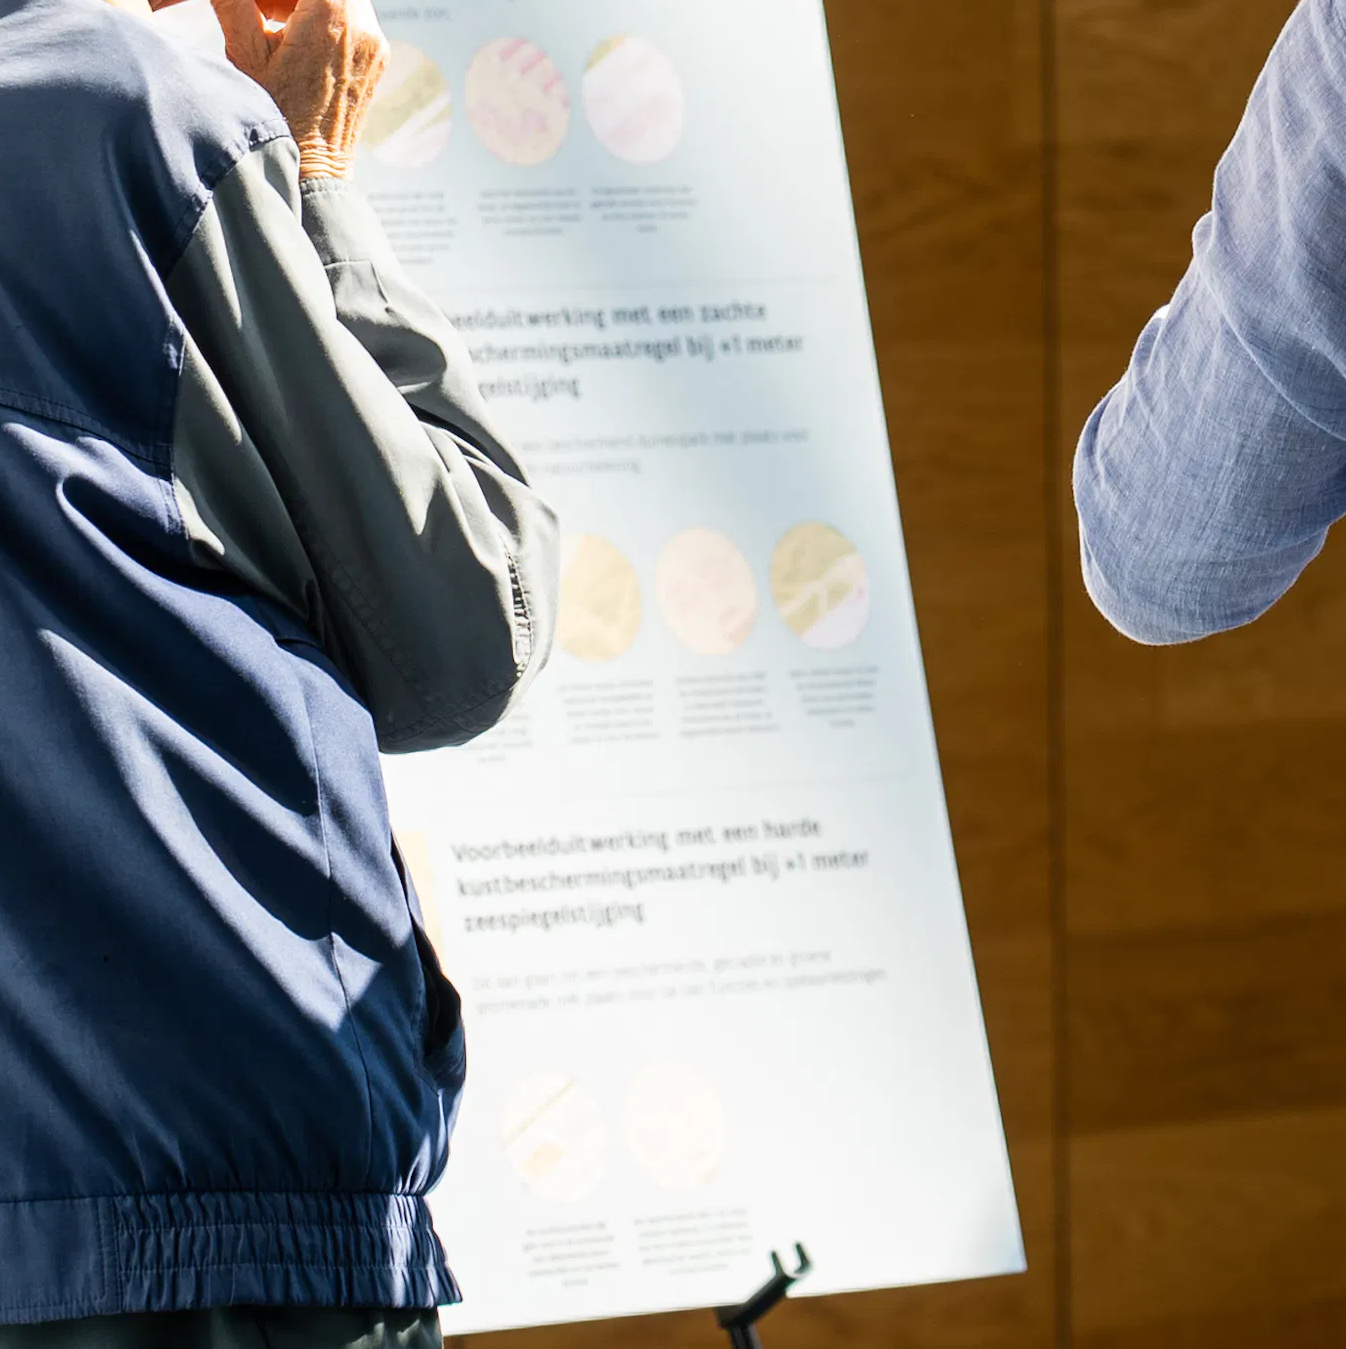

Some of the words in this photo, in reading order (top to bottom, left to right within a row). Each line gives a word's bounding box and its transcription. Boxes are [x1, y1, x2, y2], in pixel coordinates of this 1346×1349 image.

[611, 304, 651, 326] met
[658, 303, 695, 323] een
[700, 299, 768, 323] zachte
[686, 334, 715, 363] bij
[745, 334, 805, 354] meter
[451, 831, 670, 863] Voorbeelduitwerking
[676, 825, 715, 845] met
[722, 823, 758, 842] een
[762, 816, 822, 839] harde
[456, 856, 746, 896] kustbeschermingsmaatregel
[751, 854, 780, 881] bij
[811, 849, 870, 871] meter
[464, 901, 646, 934] zeespiegelstijging
